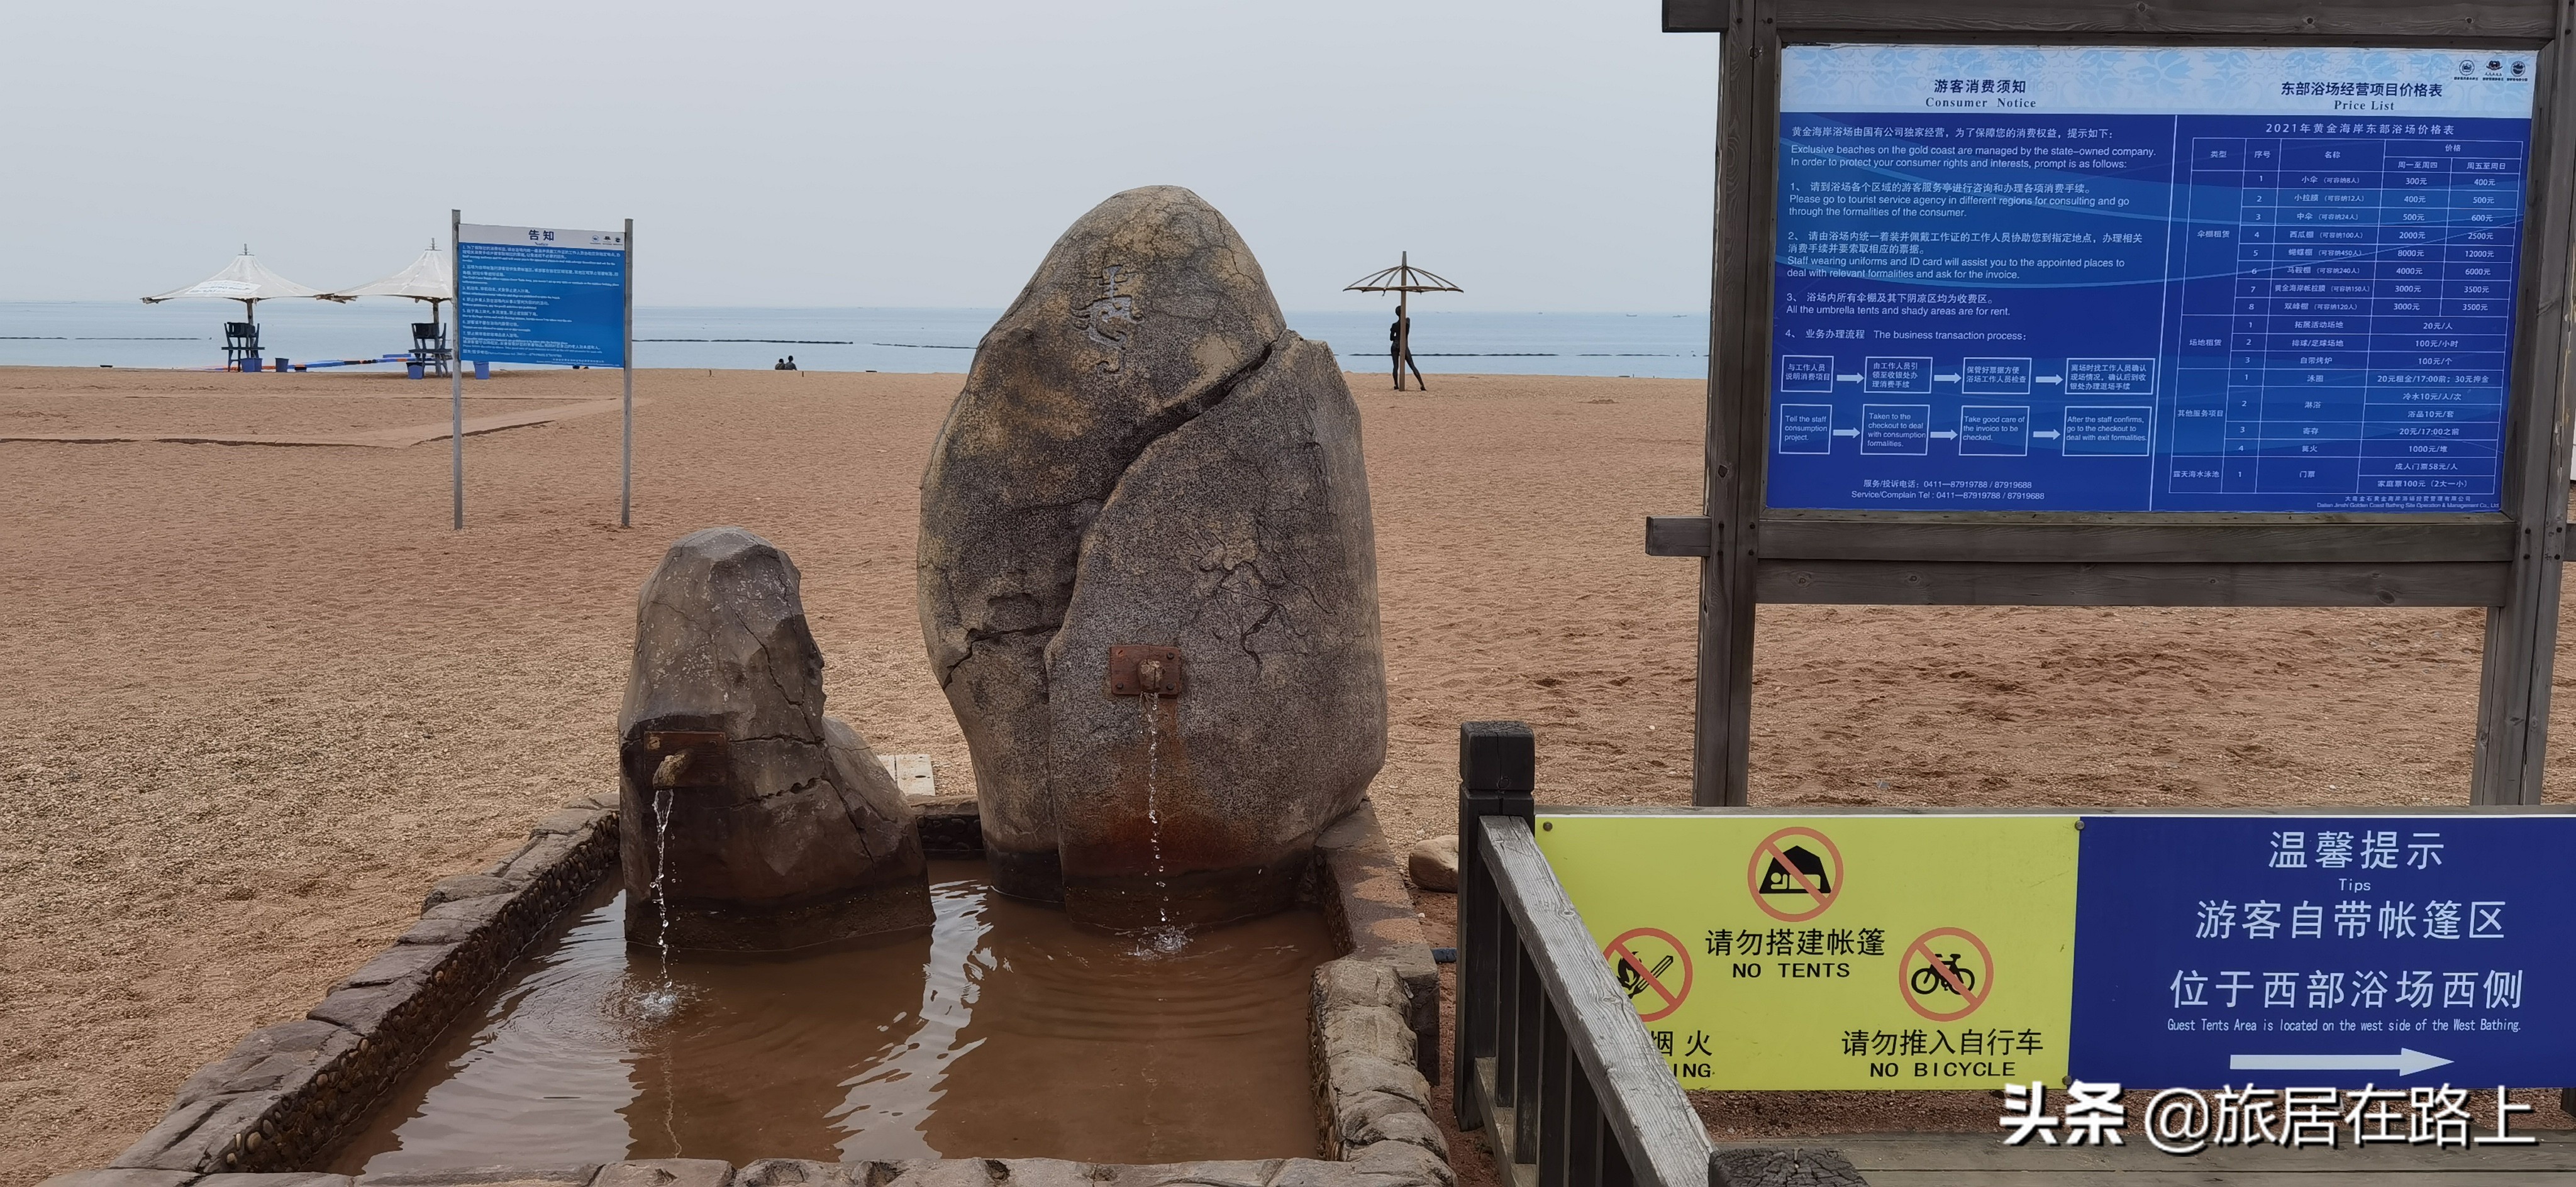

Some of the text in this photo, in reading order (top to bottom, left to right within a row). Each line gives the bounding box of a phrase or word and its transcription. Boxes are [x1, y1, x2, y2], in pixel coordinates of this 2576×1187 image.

[1934, 79, 2026, 93] 游客消费须知
[2281, 81, 2442, 97] 东部浴场经营项目价格表
[1926, 97, 2036, 108] Consumer Notice
[2334, 100, 2394, 110] Price List
[2265, 123, 2454, 135] 2021年黄金海岸东部浴场价格表
[1791, 144, 1835, 155] Exclusive
[1836, 145, 1875, 154] beaches
[1892, 145, 1906, 154] the
[1909, 145, 1928, 156] gold
[1930, 146, 1955, 155] coast
[1975, 146, 2018, 157] managed
[2020, 146, 2031, 157] by
[2034, 146, 2048, 155] the
[2112, 148, 2156, 158] company.
[2254, 150, 2270, 158] 序号
[1791, 157, 1799, 165] In
[1801, 157, 1826, 165] order
[1828, 157, 1837, 165] to
[1840, 157, 1871, 168] protect
[1873, 159, 1894, 168] your
[1943, 158, 1968, 168] rights
[1970, 158, 1988, 167] and
[1990, 158, 2031, 168] interests,
[2034, 160, 2066, 169] prompt
[2068, 159, 2076, 168] is
[2092, 159, 2126, 168] follows:
[2467, 162, 2506, 170] 周五至周日
[528, 229, 555, 241] 告知
[1786, 305, 1797, 313] All
[1800, 305, 1814, 313] the
[1816, 306, 1855, 314] umbrella
[1882, 306, 1899, 314] and
[1901, 306, 1928, 317] shady
[1975, 306, 1989, 315] for
[1990, 307, 2010, 316] rent.
[1806, 329, 1865, 339] 业务办理流程
[1873, 330, 1890, 338] The
[1893, 330, 1933, 339] business
[1935, 331, 1984, 340] transaction
[1852, 490, 1916, 499] Service/Complain
[2268, 830, 2444, 870] 温馨提示
[2338, 878, 2370, 893] Tips
[2196, 899, 2506, 939] 游客自带帐篷区
[1705, 927, 1885, 956] 请勿搭建帐篷
[1733, 963, 1850, 978] NO TENTS
[2170, 969, 2523, 1008] 位于西部浴场西侧
[2167, 1018, 2521, 1032] Guest Tents Area is located on the west side of the West Bathing.
[1841, 1028, 2043, 1056] 请勿推入自行车
[1674, 1064, 1711, 1078] ING
[1870, 1062, 2015, 1077] NO BICYCLE
